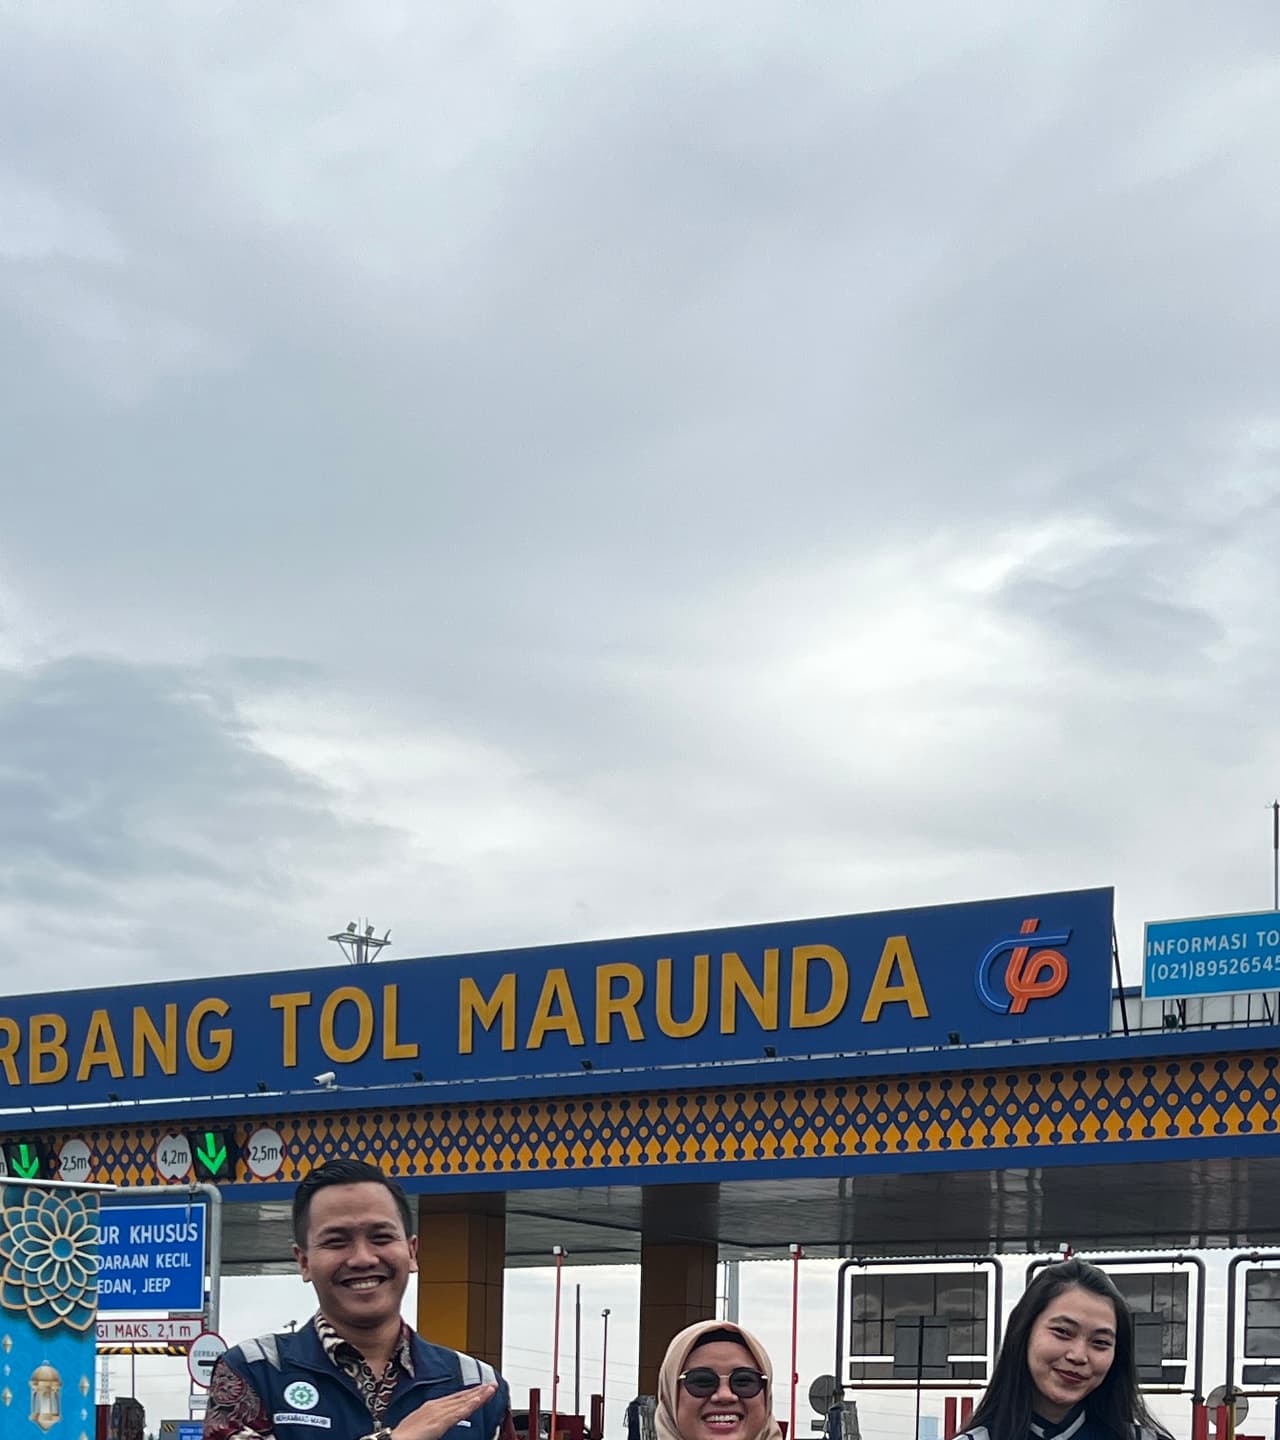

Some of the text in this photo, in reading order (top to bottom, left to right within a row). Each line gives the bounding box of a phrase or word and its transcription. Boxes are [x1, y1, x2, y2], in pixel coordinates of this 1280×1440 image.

[1147, 933, 1247, 957] INFORMASI
[270, 983, 418, 1068] TOL
[458, 935, 930, 1055] MARUNDA
[62, 1155, 87, 1173] 2,5m
[160, 1149, 188, 1167] 4,2m
[251, 1145, 278, 1164] 2,5m
[98, 1222, 199, 1245] UR KHUSUS
[96, 1252, 192, 1271] DARAAN KECIL
[96, 1277, 172, 1296] EDAN, JEEP
[96, 1322, 191, 1340] GI MAKS. 2,1 m
